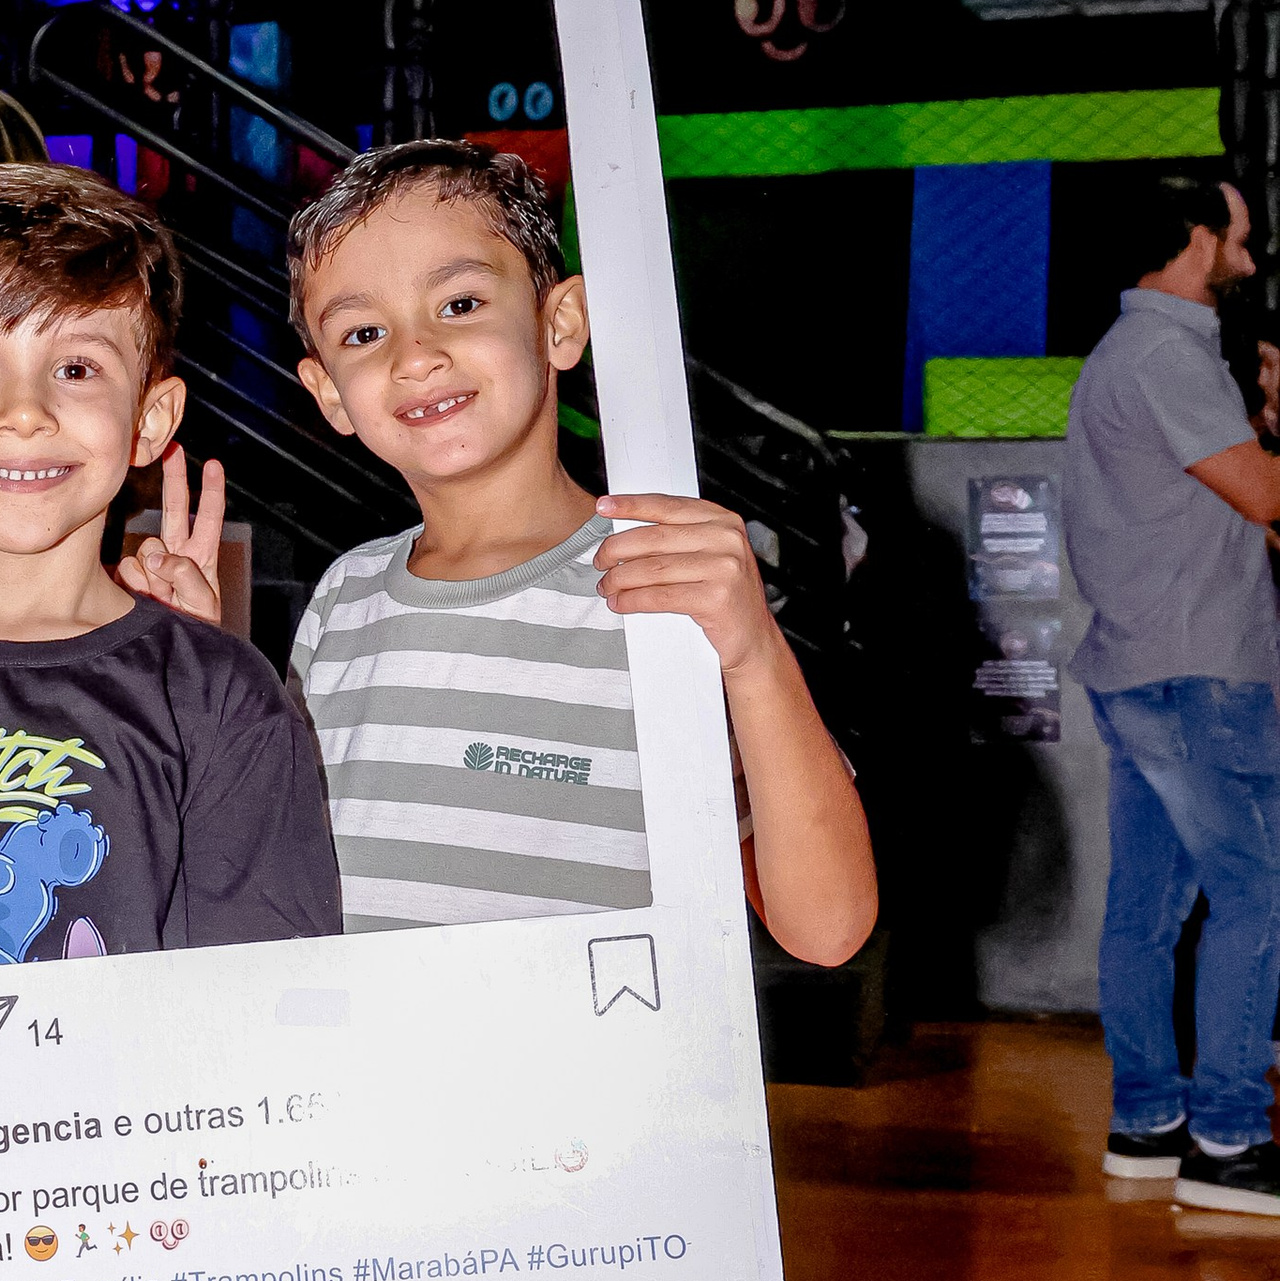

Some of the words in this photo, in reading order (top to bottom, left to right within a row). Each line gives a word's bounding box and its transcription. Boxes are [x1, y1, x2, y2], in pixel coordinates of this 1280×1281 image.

[494, 760, 512, 775] IN
[517, 764, 590, 786] NATURE
[495, 745, 593, 772] RECHARGE
[27, 1018, 64, 1047] 14
[113, 1114, 133, 1136] e
[143, 1102, 245, 1135] outras
[32, 1179, 139, 1217] parque
[149, 1171, 187, 1202] de
[526, 1233, 689, 1270] #GurupiTO
